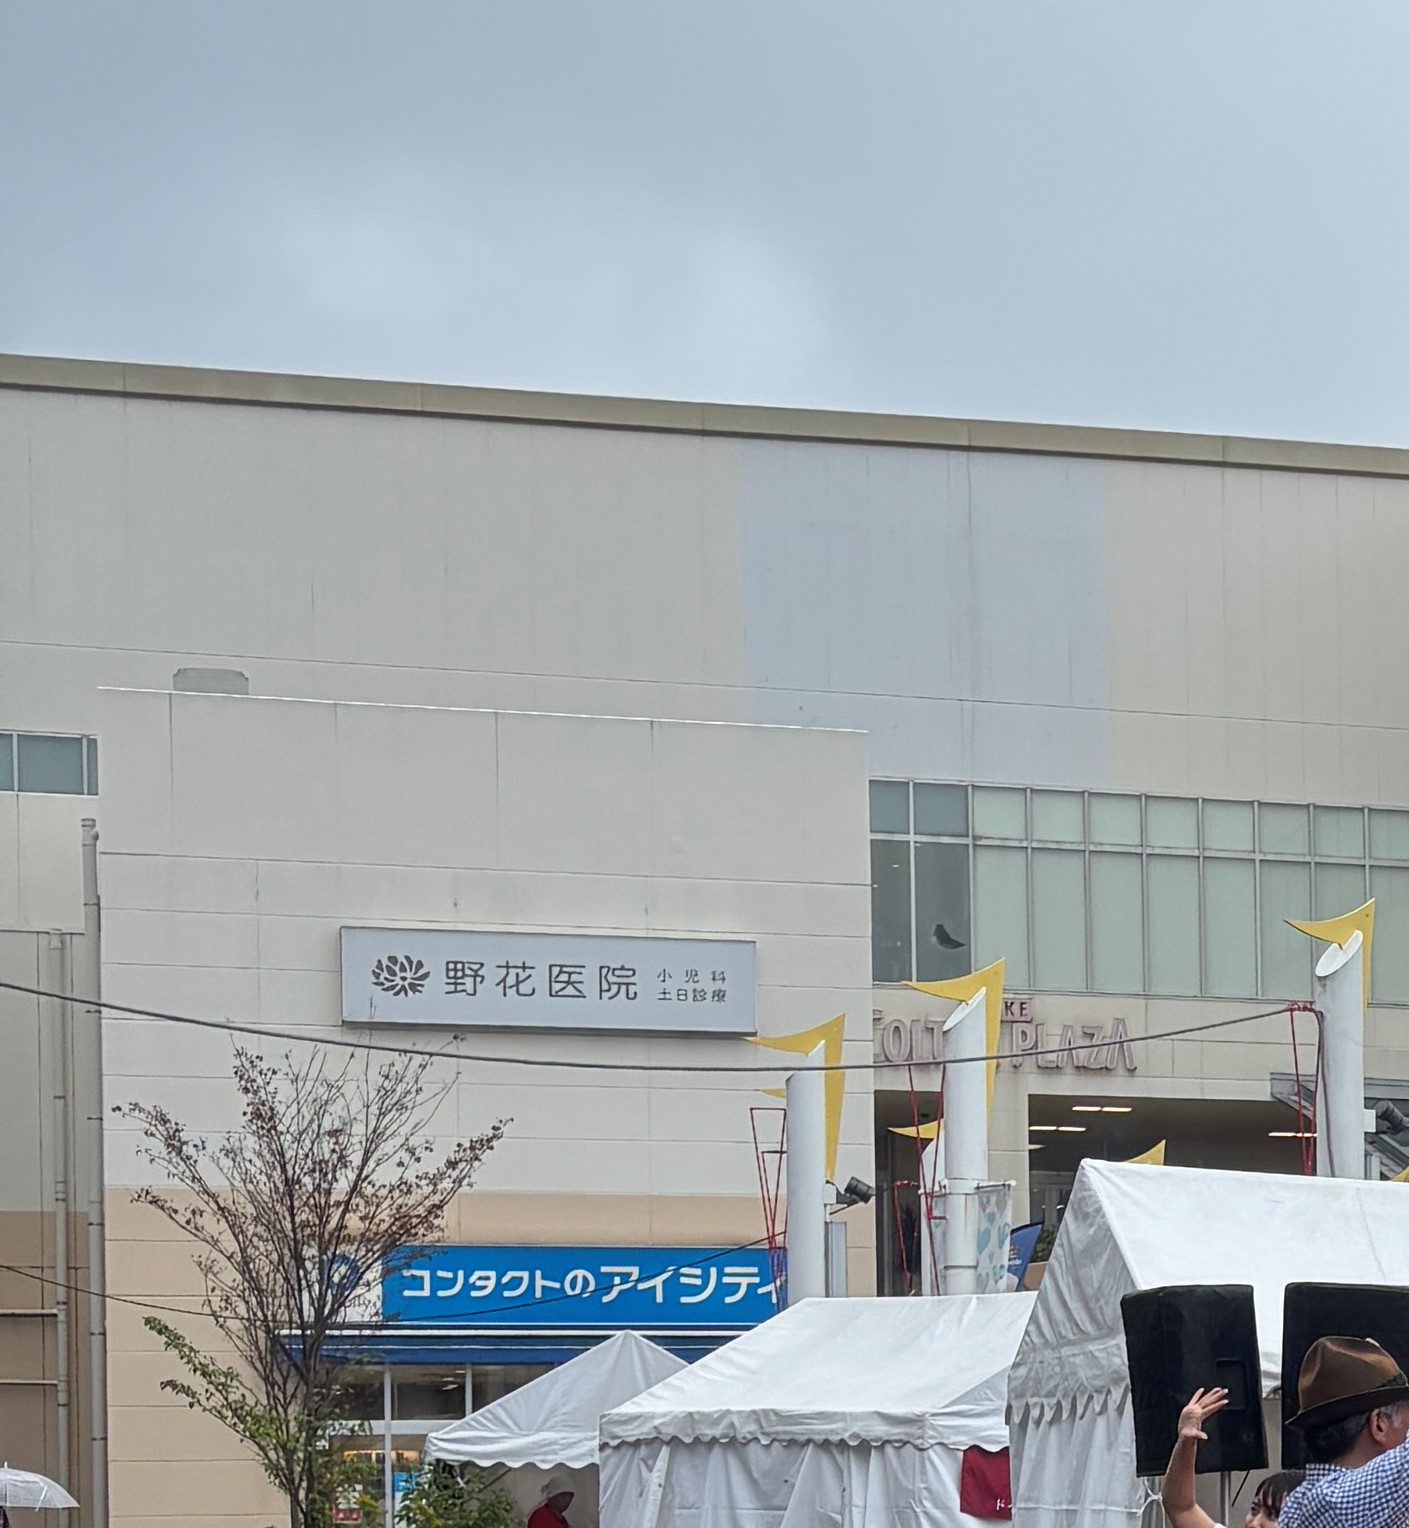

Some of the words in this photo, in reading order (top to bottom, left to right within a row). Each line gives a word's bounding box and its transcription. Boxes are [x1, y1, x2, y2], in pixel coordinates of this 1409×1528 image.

[444, 960, 638, 1001] 野花医院
[1012, 1017, 1138, 1071] PLAZA
